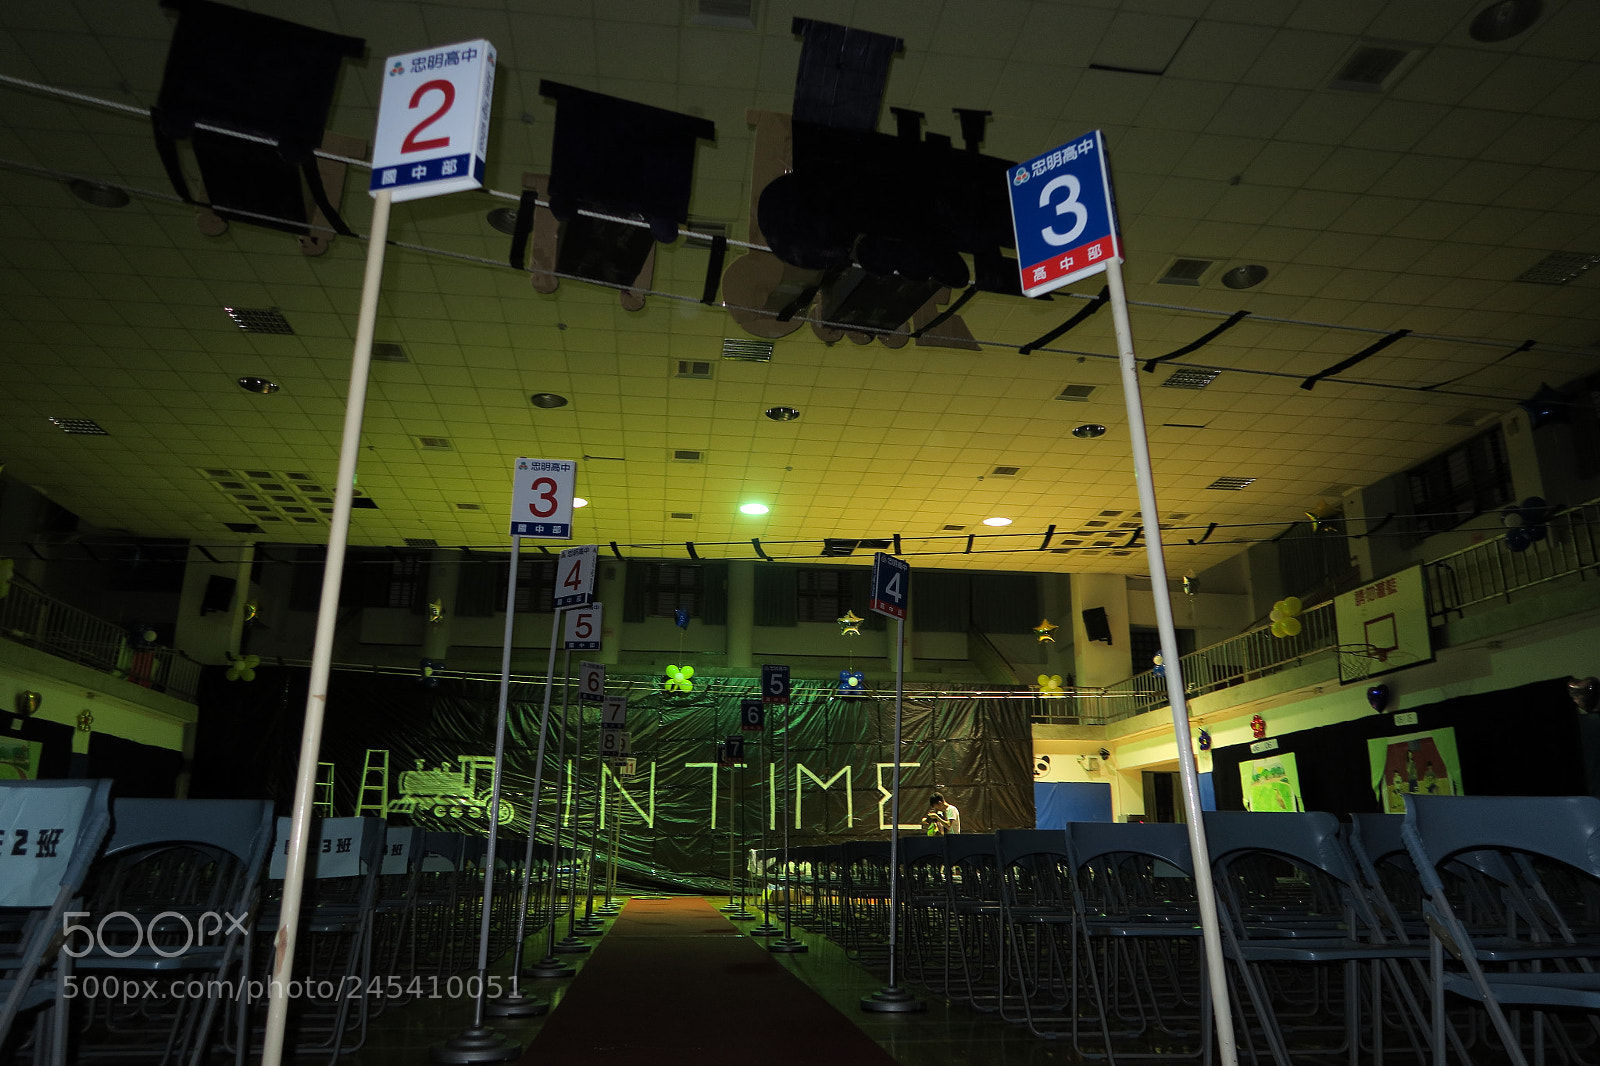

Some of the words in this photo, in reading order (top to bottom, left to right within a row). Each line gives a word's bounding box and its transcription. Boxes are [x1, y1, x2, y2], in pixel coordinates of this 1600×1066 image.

[410, 48, 478, 73] 忠明高中
[400, 79, 456, 154] 2
[1030, 138, 1094, 178] 忠明高中
[1038, 173, 1088, 247] 3
[1032, 243, 1102, 283] 高中部
[530, 461, 571, 472] 忠明高中
[529, 477, 558, 518] 3
[563, 559, 582, 591] 4
[885, 572, 902, 603] 4
[575, 613, 593, 639] 5
[587, 671, 599, 692] 6
[769, 673, 784, 695] 5
[609, 703, 621, 721] 7
[747, 705, 759, 724] 6
[604, 733, 615, 750] 8
[730, 741, 740, 757] 7
[684, 761, 921, 831] TIME
